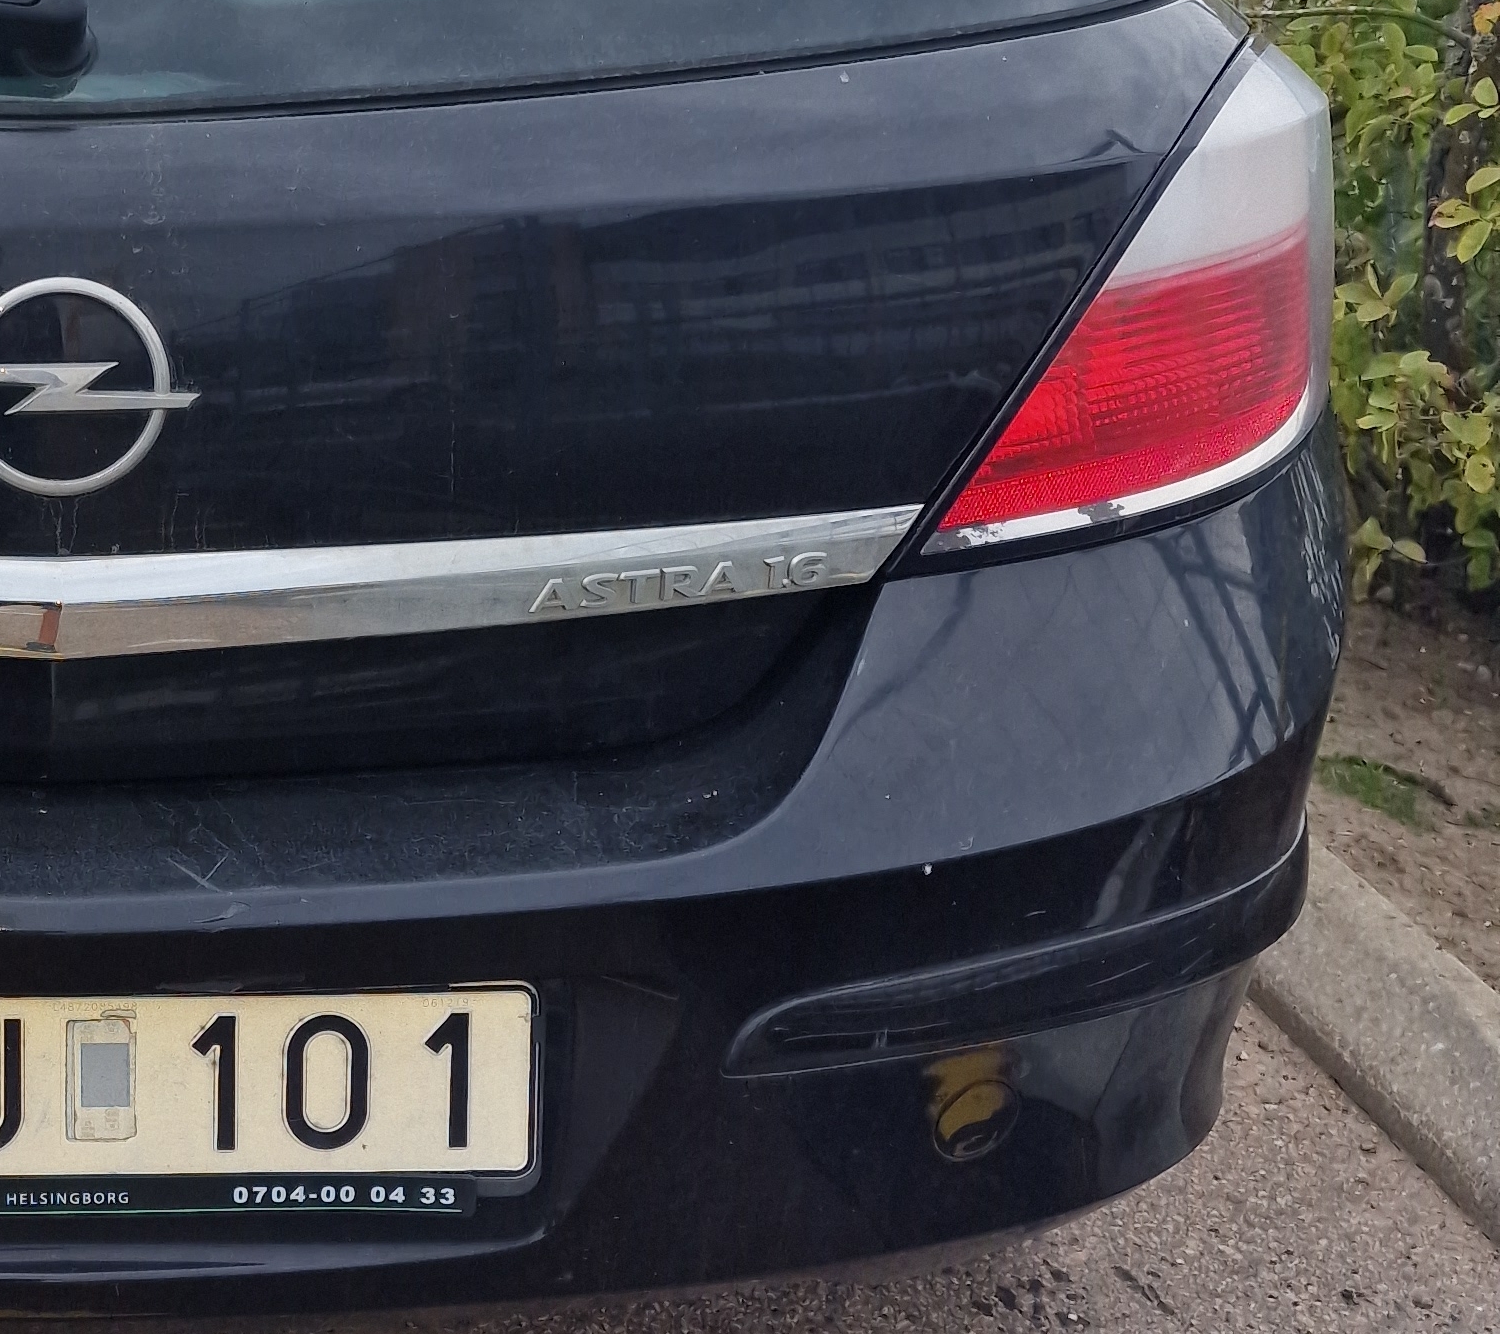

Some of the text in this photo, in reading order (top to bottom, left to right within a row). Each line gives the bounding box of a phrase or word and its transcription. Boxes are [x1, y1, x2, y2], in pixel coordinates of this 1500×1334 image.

[528, 552, 828, 614] ASTRA 1.6
[191, 1012, 470, 1151] 101
[6, 1191, 130, 1206] HELSINGBORG
[233, 1186, 457, 1205] 0704-00 04 33
